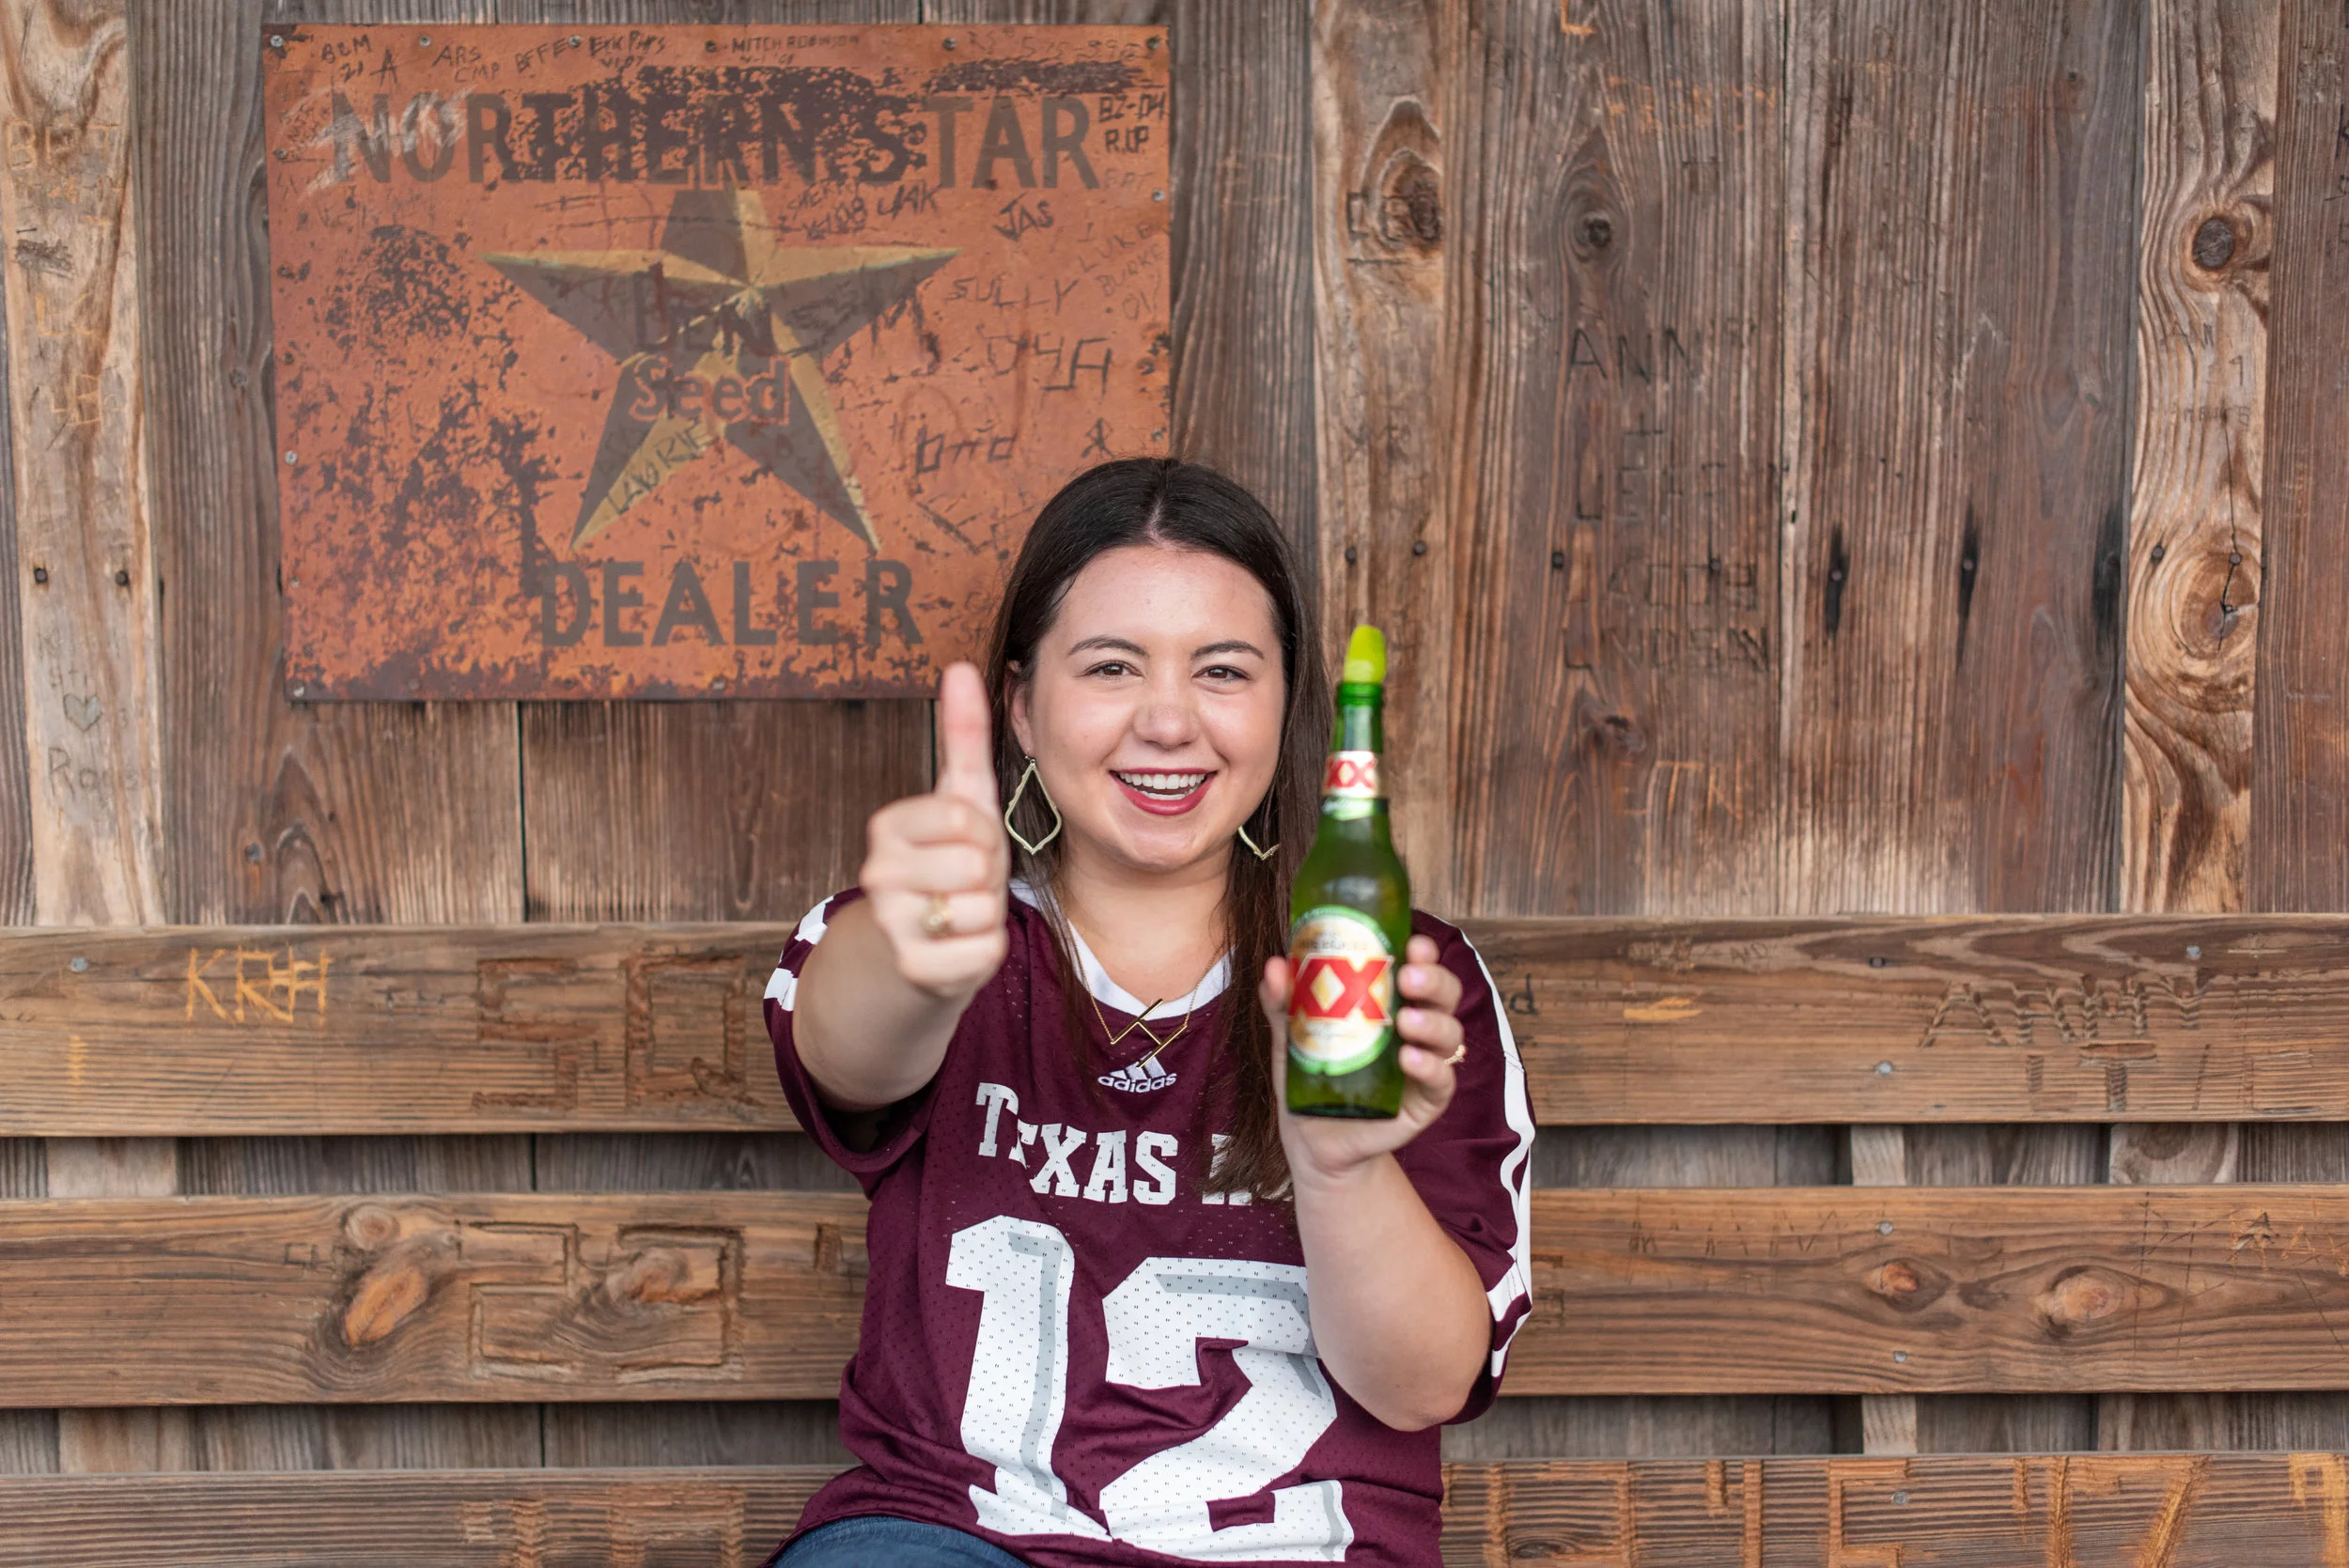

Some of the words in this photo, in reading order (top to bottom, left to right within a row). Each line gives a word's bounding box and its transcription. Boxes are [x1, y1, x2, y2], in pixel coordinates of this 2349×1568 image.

[332, 88, 817, 186] NORTHERN
[839, 93, 1100, 190] STAR
[629, 354, 790, 426] Seed
[541, 559, 925, 648] DEALER
[1325, 758, 1376, 790] XX
[1288, 955, 1396, 1021] XX
[1097, 1071, 1177, 1094] adidas
[945, 1214, 1355, 1562] 12
